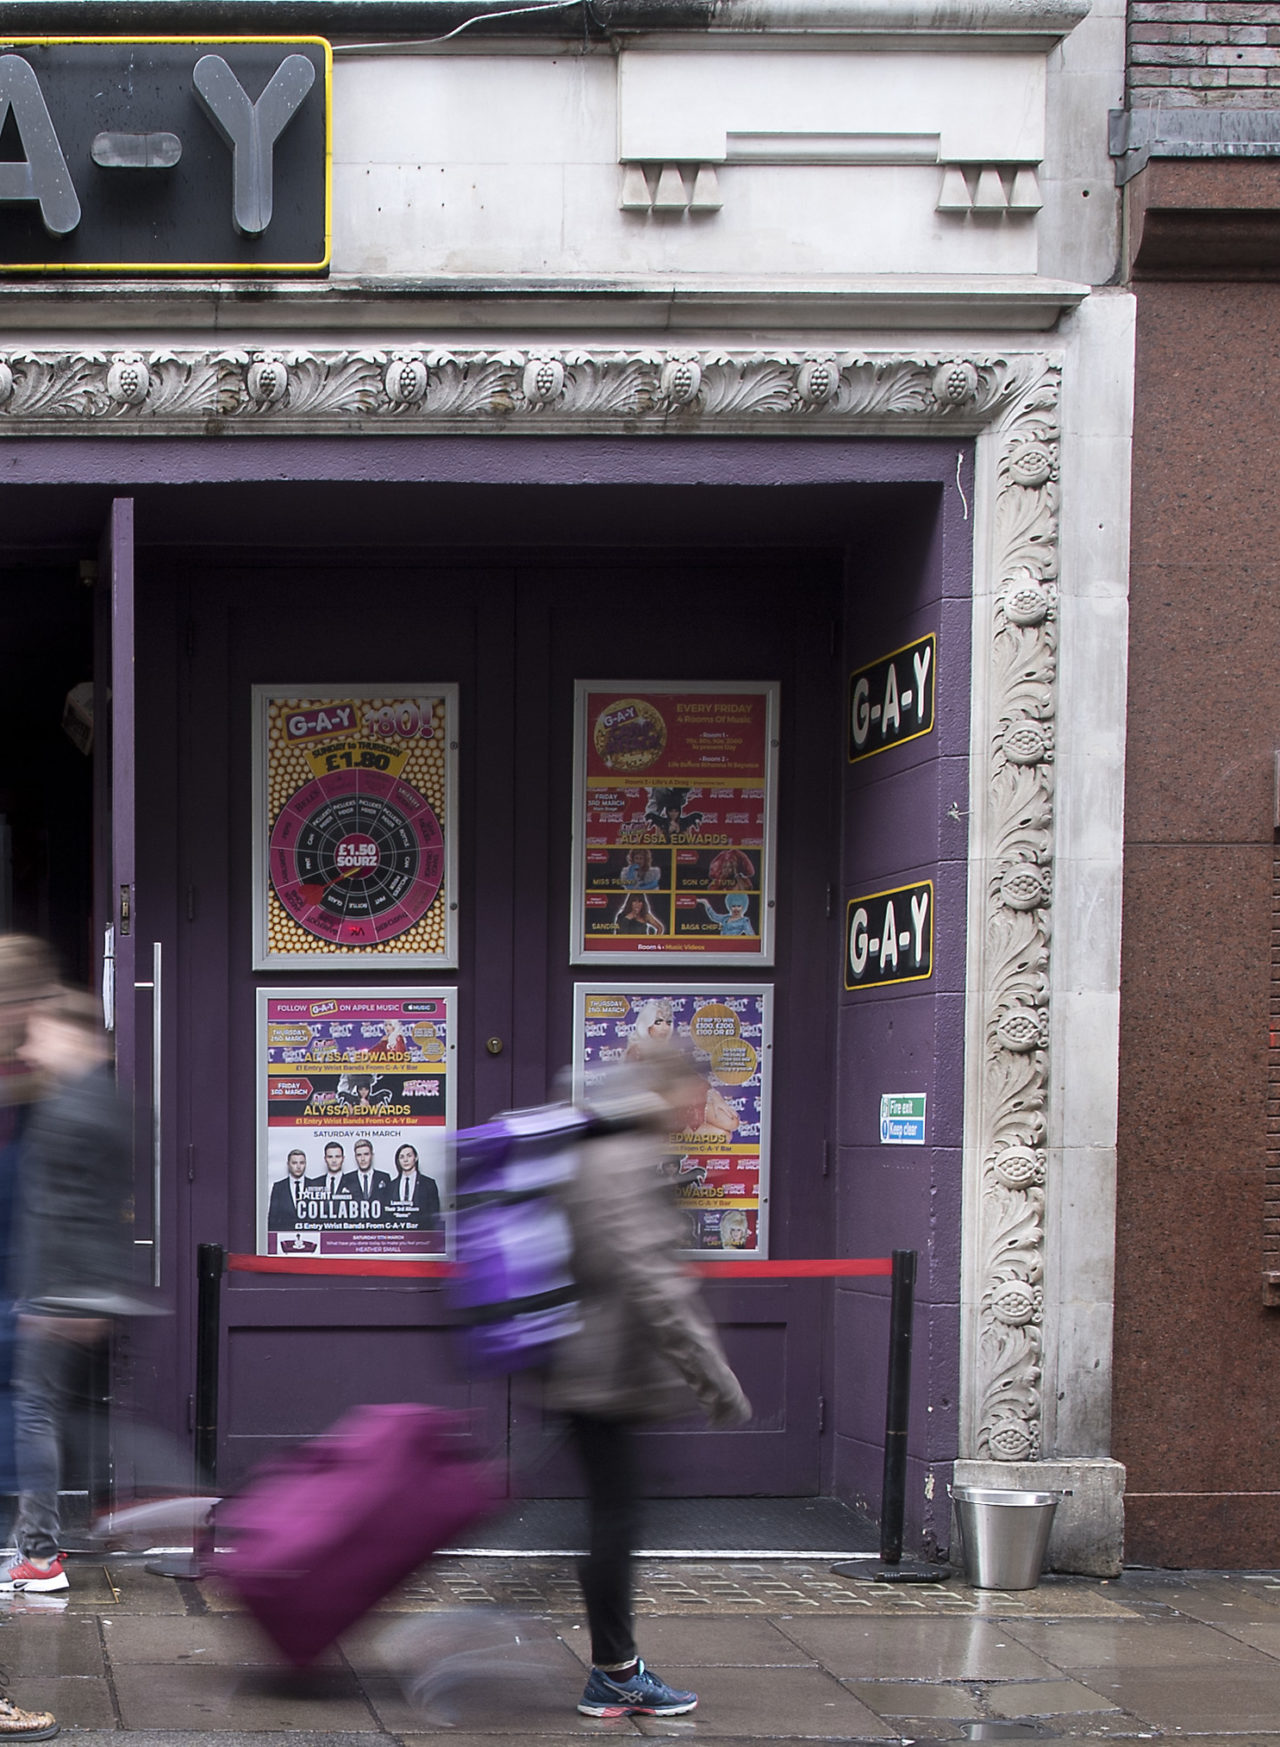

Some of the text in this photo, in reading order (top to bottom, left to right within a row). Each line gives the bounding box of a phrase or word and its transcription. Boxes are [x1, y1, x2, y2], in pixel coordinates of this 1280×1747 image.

[852, 645, 931, 747] G-A-Y
[676, 703, 753, 713] EVERY FRIDAY
[288, 706, 351, 737] G-A-Y
[604, 707, 634, 727] G-A-Y
[311, 742, 346, 759] SUNDAY
[358, 742, 402, 757] THURSDAY
[326, 750, 390, 772] £1.80
[621, 833, 728, 844] ALYSSA EDWARDS
[337, 843, 377, 856] £1.50
[336, 855, 378, 867] SOURZ
[850, 892, 929, 976] G-A-Y
[312, 1002, 334, 1014] G-A-Y
[304, 1052, 349, 1062] ALYSSA
[353, 1052, 411, 1062] EDWARDS
[303, 1105, 411, 1115] ALYSSA EDWARDS
[890, 1100, 913, 1114] Fire exit
[303, 1118, 322, 1126] Entry
[890, 1121, 918, 1138] Keep clear
[670, 1132, 726, 1143] EDWARDS
[296, 1200, 381, 1219] COLLABRO
[304, 1222, 323, 1231] Entry
